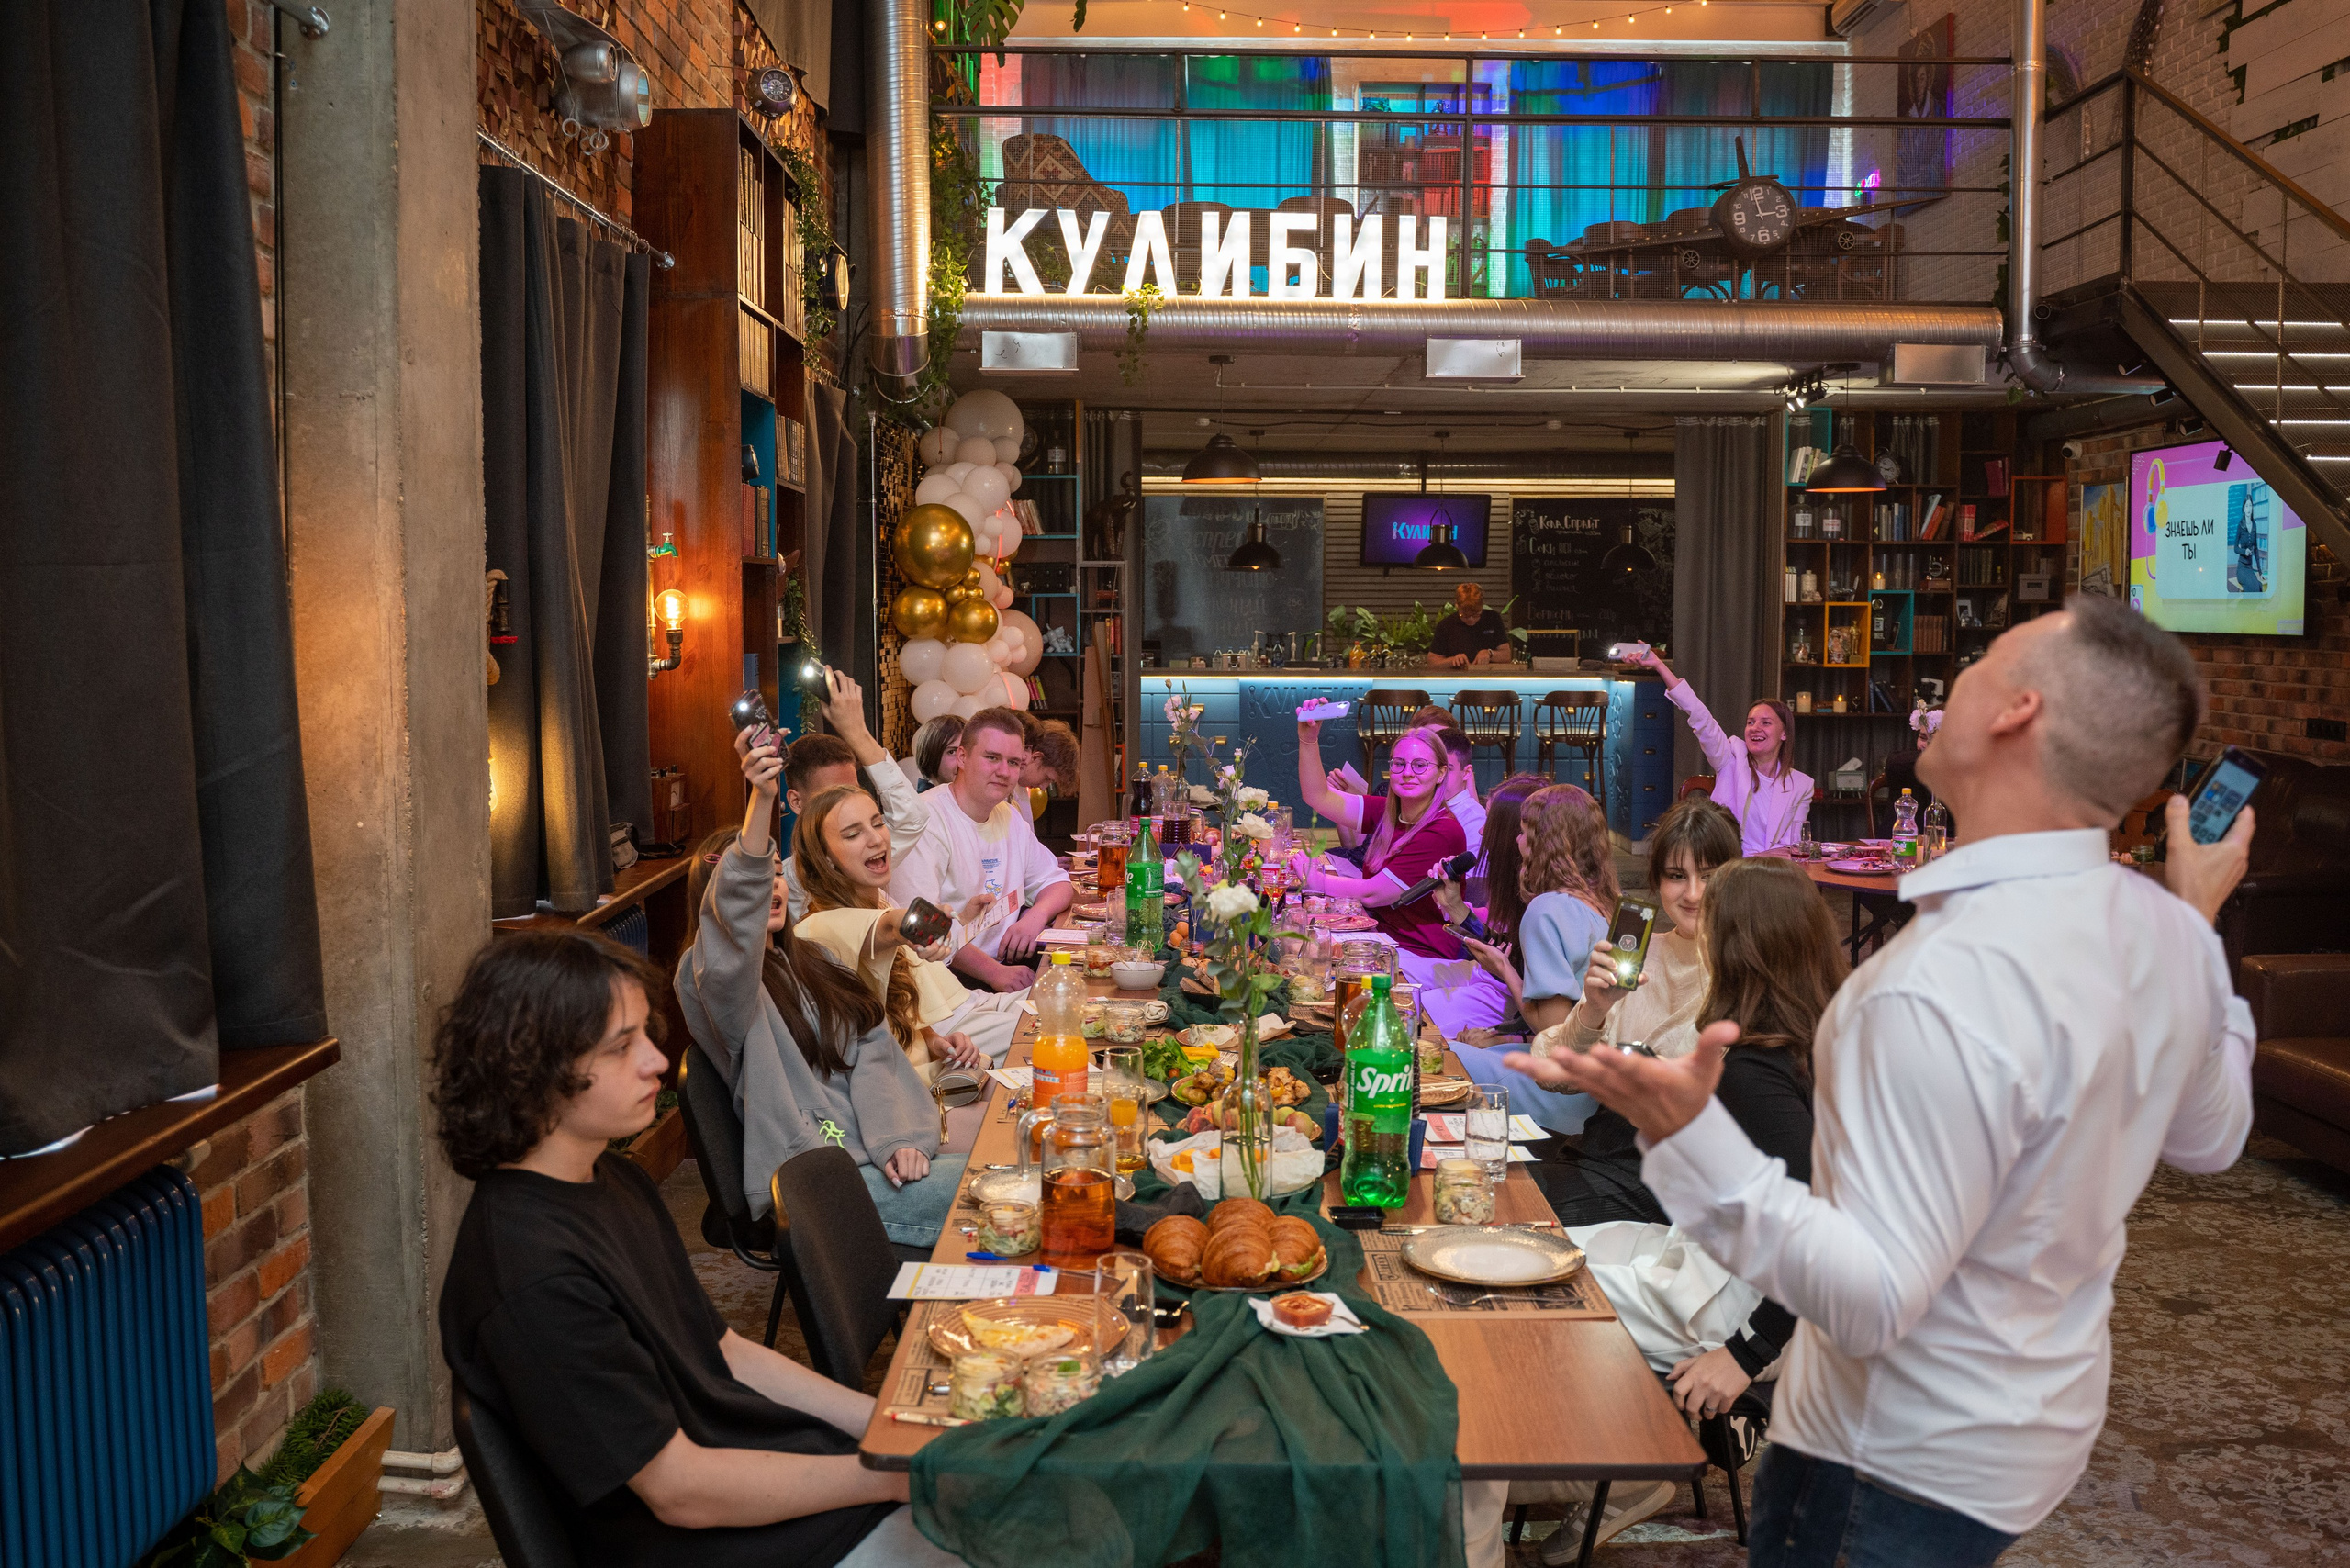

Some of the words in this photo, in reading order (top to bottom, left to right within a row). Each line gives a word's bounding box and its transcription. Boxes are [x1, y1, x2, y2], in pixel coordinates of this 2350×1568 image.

[1749, 187, 1764, 201] 12
[1733, 211, 1746, 226] 9
[1775, 205, 1787, 218] 3
[1757, 229, 1770, 242] 6
[985, 207, 1448, 300] КУЛИБИН
[2165, 520, 2199, 538] ЗНАЕШЬ
[2200, 518, 2214, 536] ЛИ
[2181, 543, 2197, 560] ТЫ
